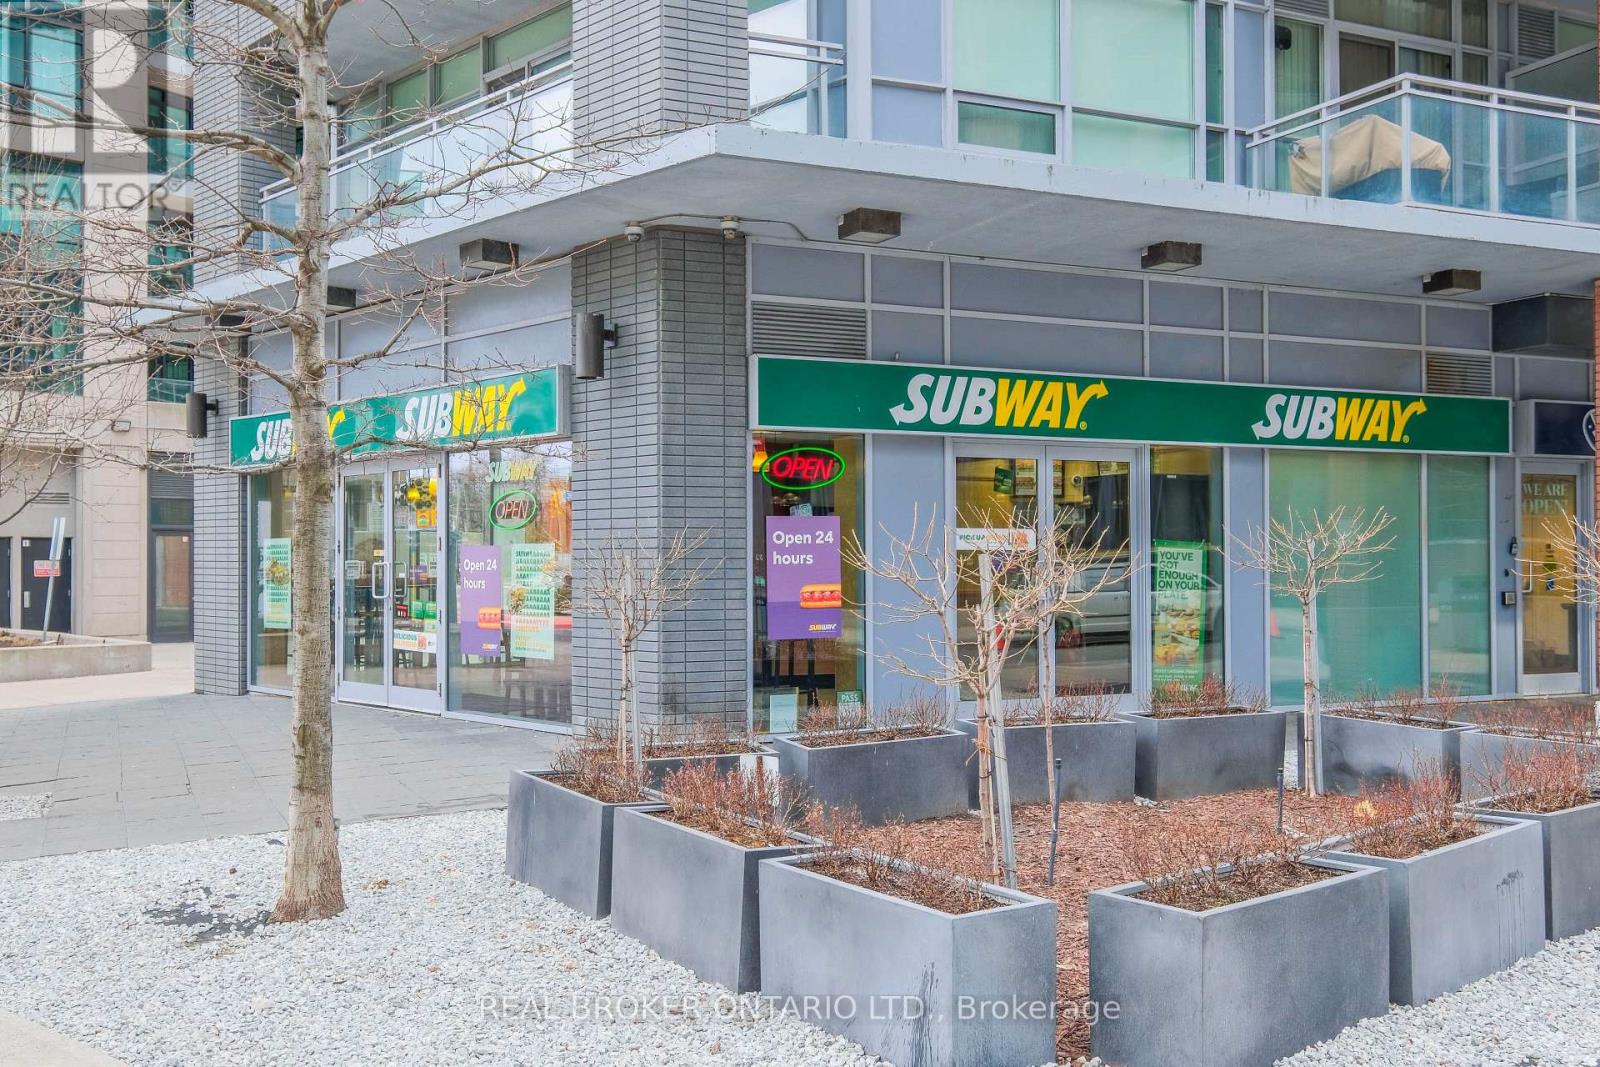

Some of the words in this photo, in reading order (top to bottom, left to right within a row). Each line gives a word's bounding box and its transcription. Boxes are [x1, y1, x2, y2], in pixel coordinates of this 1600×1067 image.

[889, 374, 1109, 430] SUBWAY
[394, 378, 526, 441] SUBWAY
[1251, 393, 1427, 443] SUBWAY
[251, 410, 345, 461] SUBY
[485, 455, 543, 483] SUBWAY
[773, 455, 834, 480] OPEN
[1522, 483, 1541, 496] WE
[1543, 483, 1568, 496] ARE
[495, 501, 529, 520] OPEN
[772, 530, 811, 547] Open
[815, 530, 834, 544] 24
[772, 551, 814, 565] hours
[1160, 551, 1194, 561] YOU'VE
[464, 559, 485, 573] Open
[487, 559, 497, 571] 24
[1159, 560, 1179, 570] GOT
[1159, 570, 1198, 580] ENOUGH
[464, 576, 486, 589] hours
[1158, 580, 1173, 589] ON
[1175, 581, 1199, 590] YOUR
[841, 694, 859, 703] PASS
